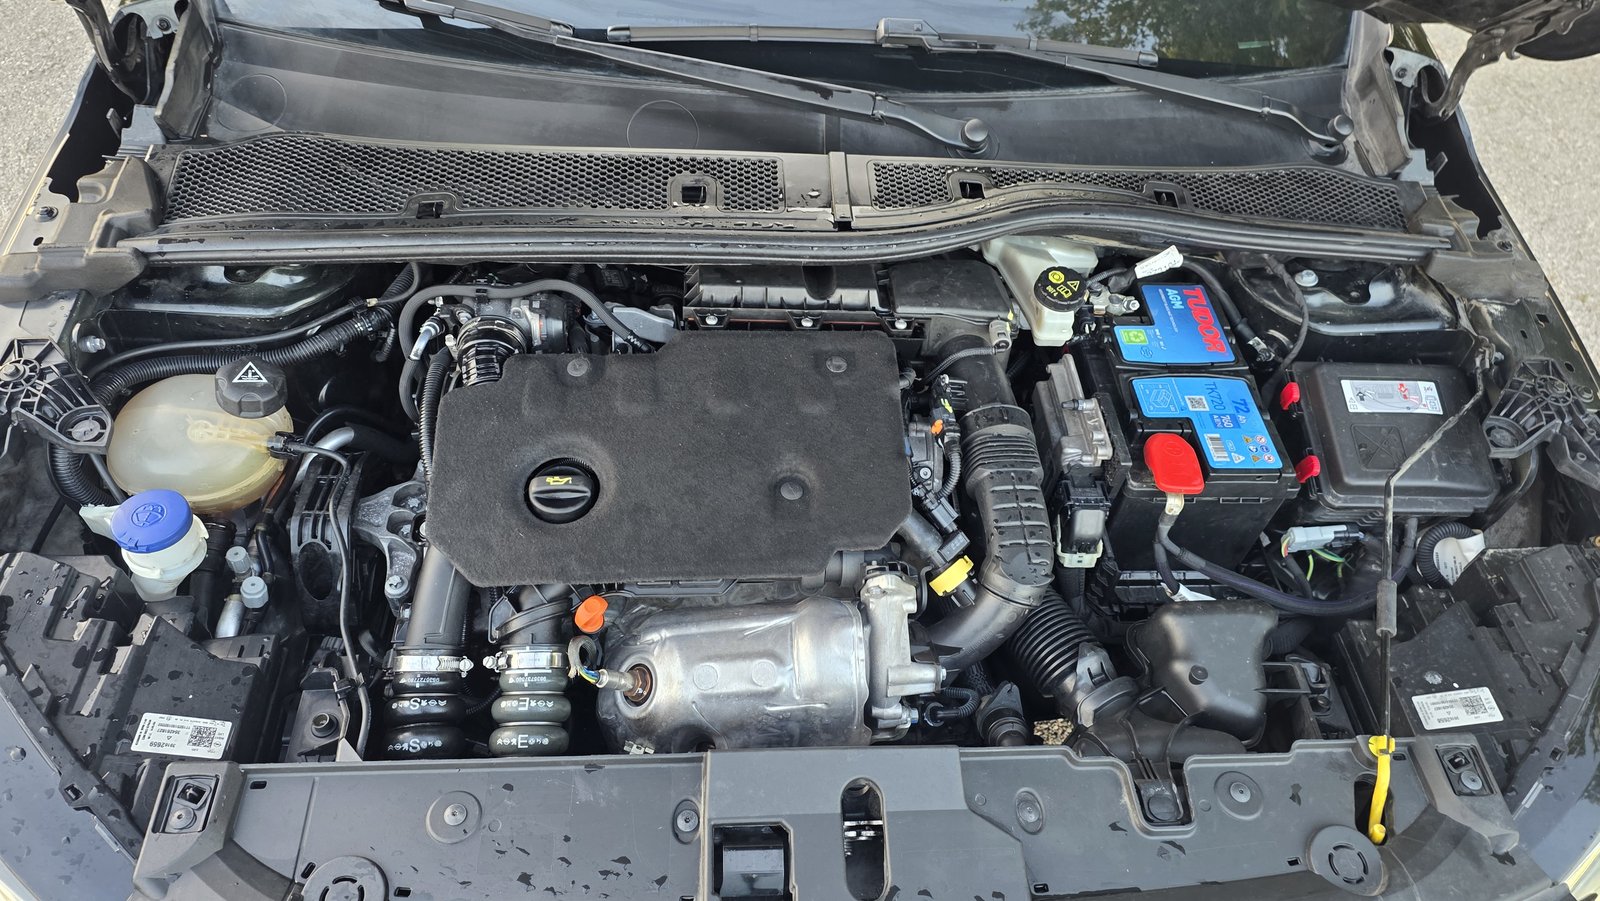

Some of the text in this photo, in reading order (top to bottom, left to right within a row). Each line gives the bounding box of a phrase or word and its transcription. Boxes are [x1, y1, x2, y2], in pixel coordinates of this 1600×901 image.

[1165, 288, 1184, 310] AGM
[1183, 287, 1226, 353] TUDOR
[1204, 381, 1226, 411] TK720
[1231, 398, 1250, 414] 72
[1220, 414, 1234, 428] 760
[409, 698, 421, 710] S
[518, 697, 529, 710] E
[409, 738, 421, 752] S
[517, 734, 529, 748] E
